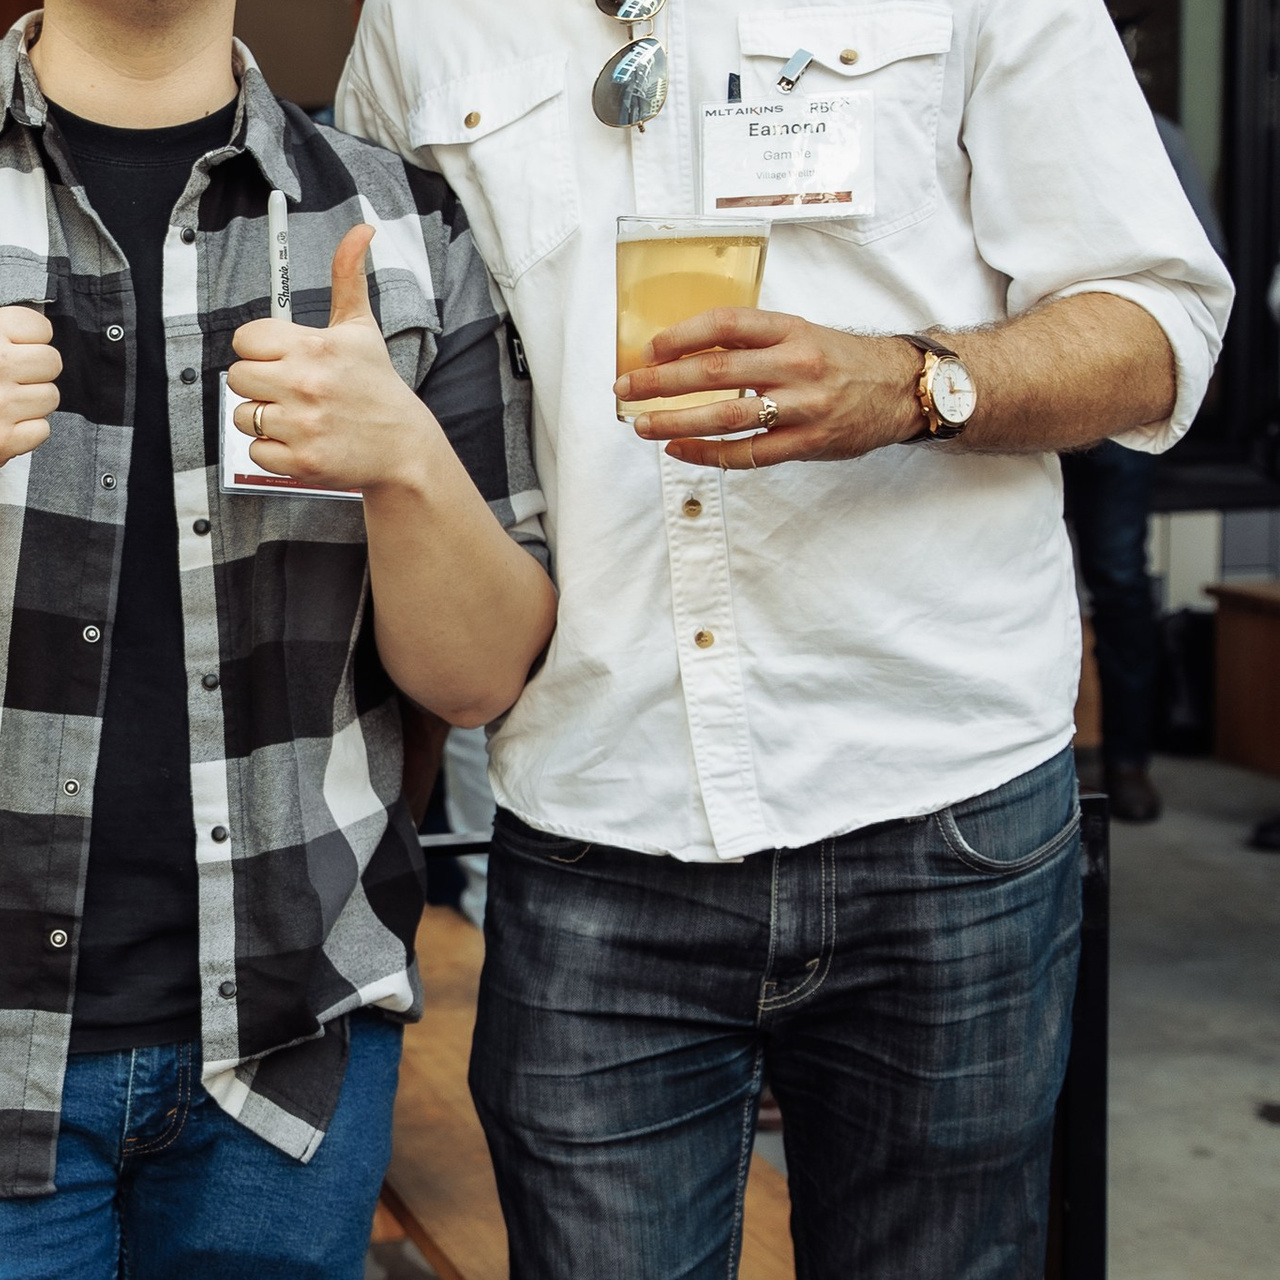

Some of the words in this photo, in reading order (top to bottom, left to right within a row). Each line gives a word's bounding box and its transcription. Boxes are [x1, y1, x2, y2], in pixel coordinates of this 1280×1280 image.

[705, 108, 734, 117] MLT
[735, 104, 784, 116] AIKINS
[763, 149, 811, 161] Game
[277, 265, 291, 309] Sharpie
